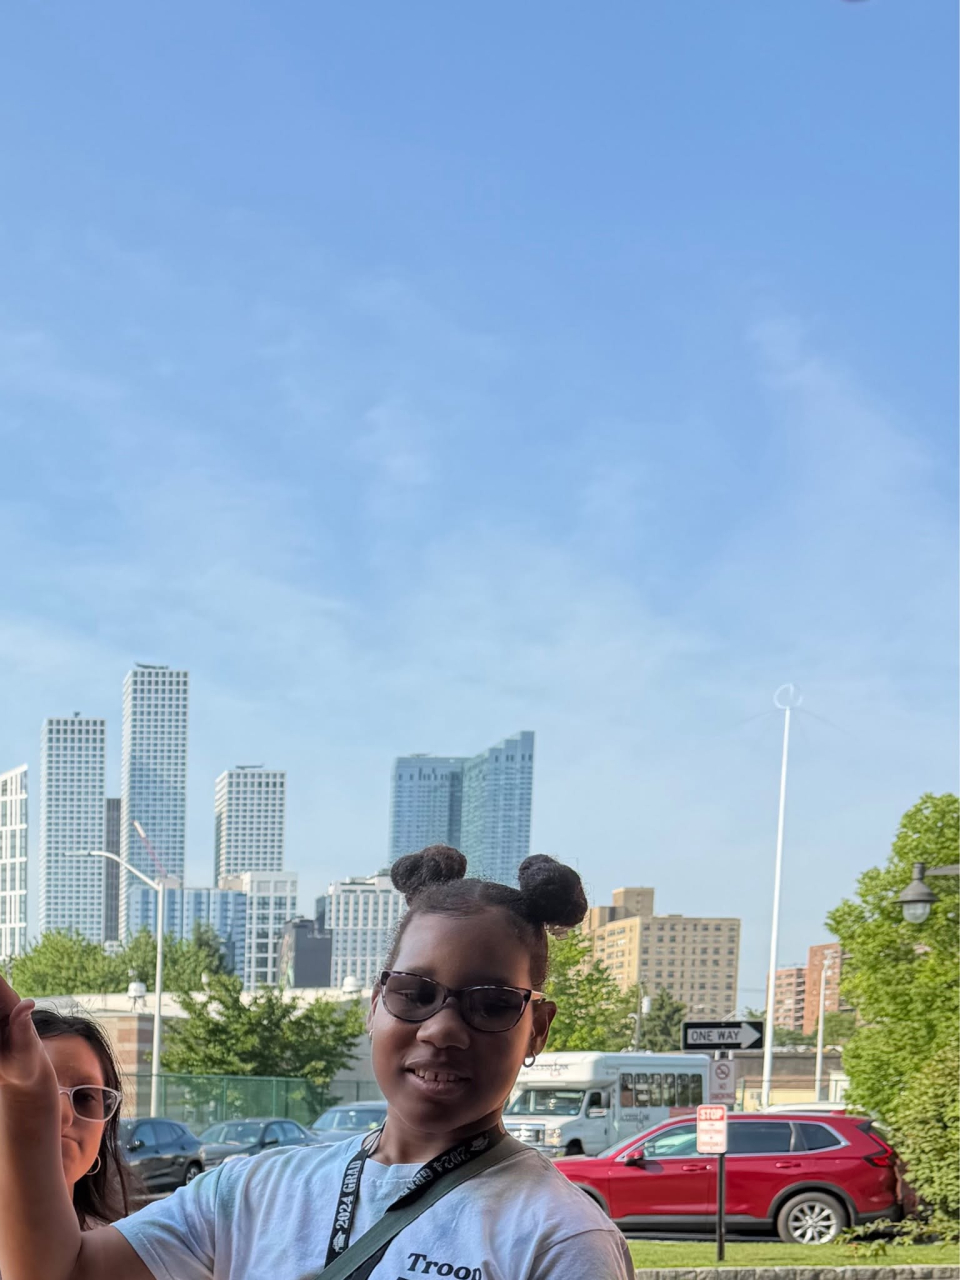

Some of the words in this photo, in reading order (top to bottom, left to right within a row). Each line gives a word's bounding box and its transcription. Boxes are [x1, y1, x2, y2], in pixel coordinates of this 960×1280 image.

[691, 1030, 713, 1042] ONE
[717, 1030, 740, 1041] WAY
[699, 1108, 724, 1120] STOP
[432, 1146, 471, 1172] 2024
[342, 1160, 363, 1193] GRAD
[335, 1195, 354, 1229] 2024
